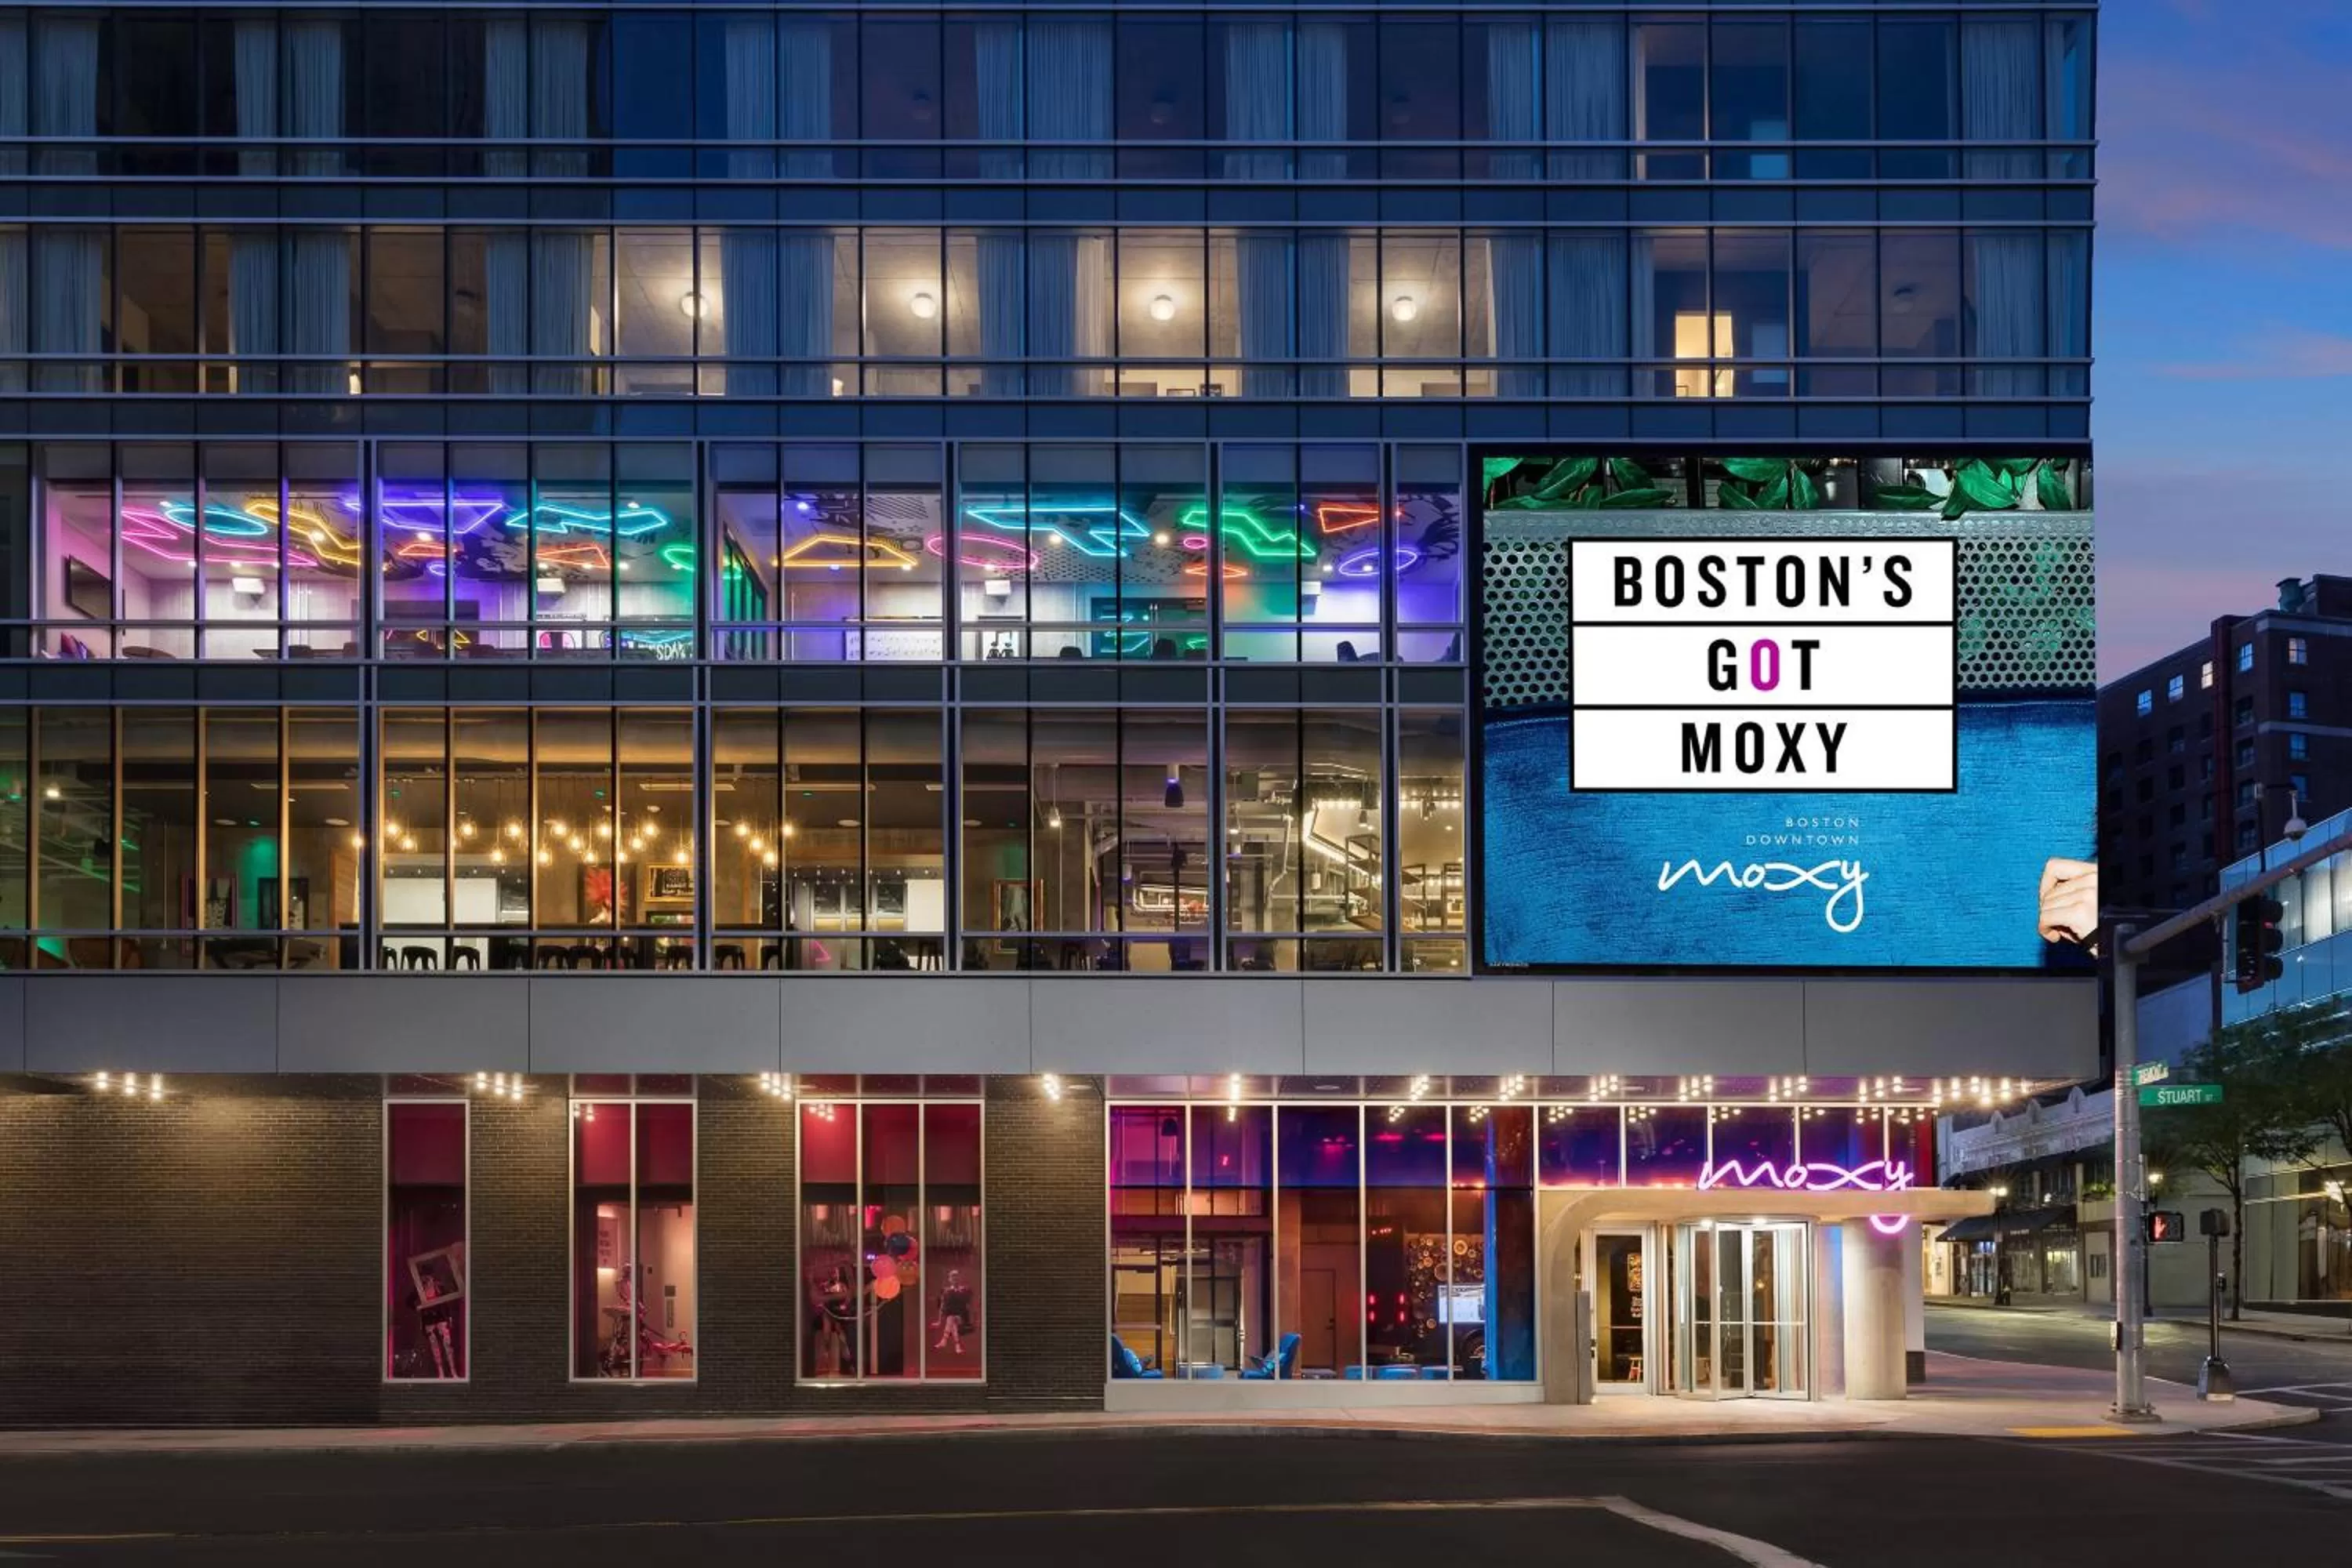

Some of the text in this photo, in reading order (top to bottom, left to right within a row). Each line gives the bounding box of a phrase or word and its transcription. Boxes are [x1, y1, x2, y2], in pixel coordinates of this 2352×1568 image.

[1614, 555, 1911, 608] BOSTON'S
[1708, 639, 1820, 691] GOT
[1682, 721, 1847, 774] MOXY
[1746, 835, 1858, 844] DOWNTOWN
[1785, 818, 1858, 827] BOSTON
[1658, 859, 1869, 932] moxy
[2158, 1089, 2202, 1104] STUART
[1697, 1160, 1914, 1234] moxy
